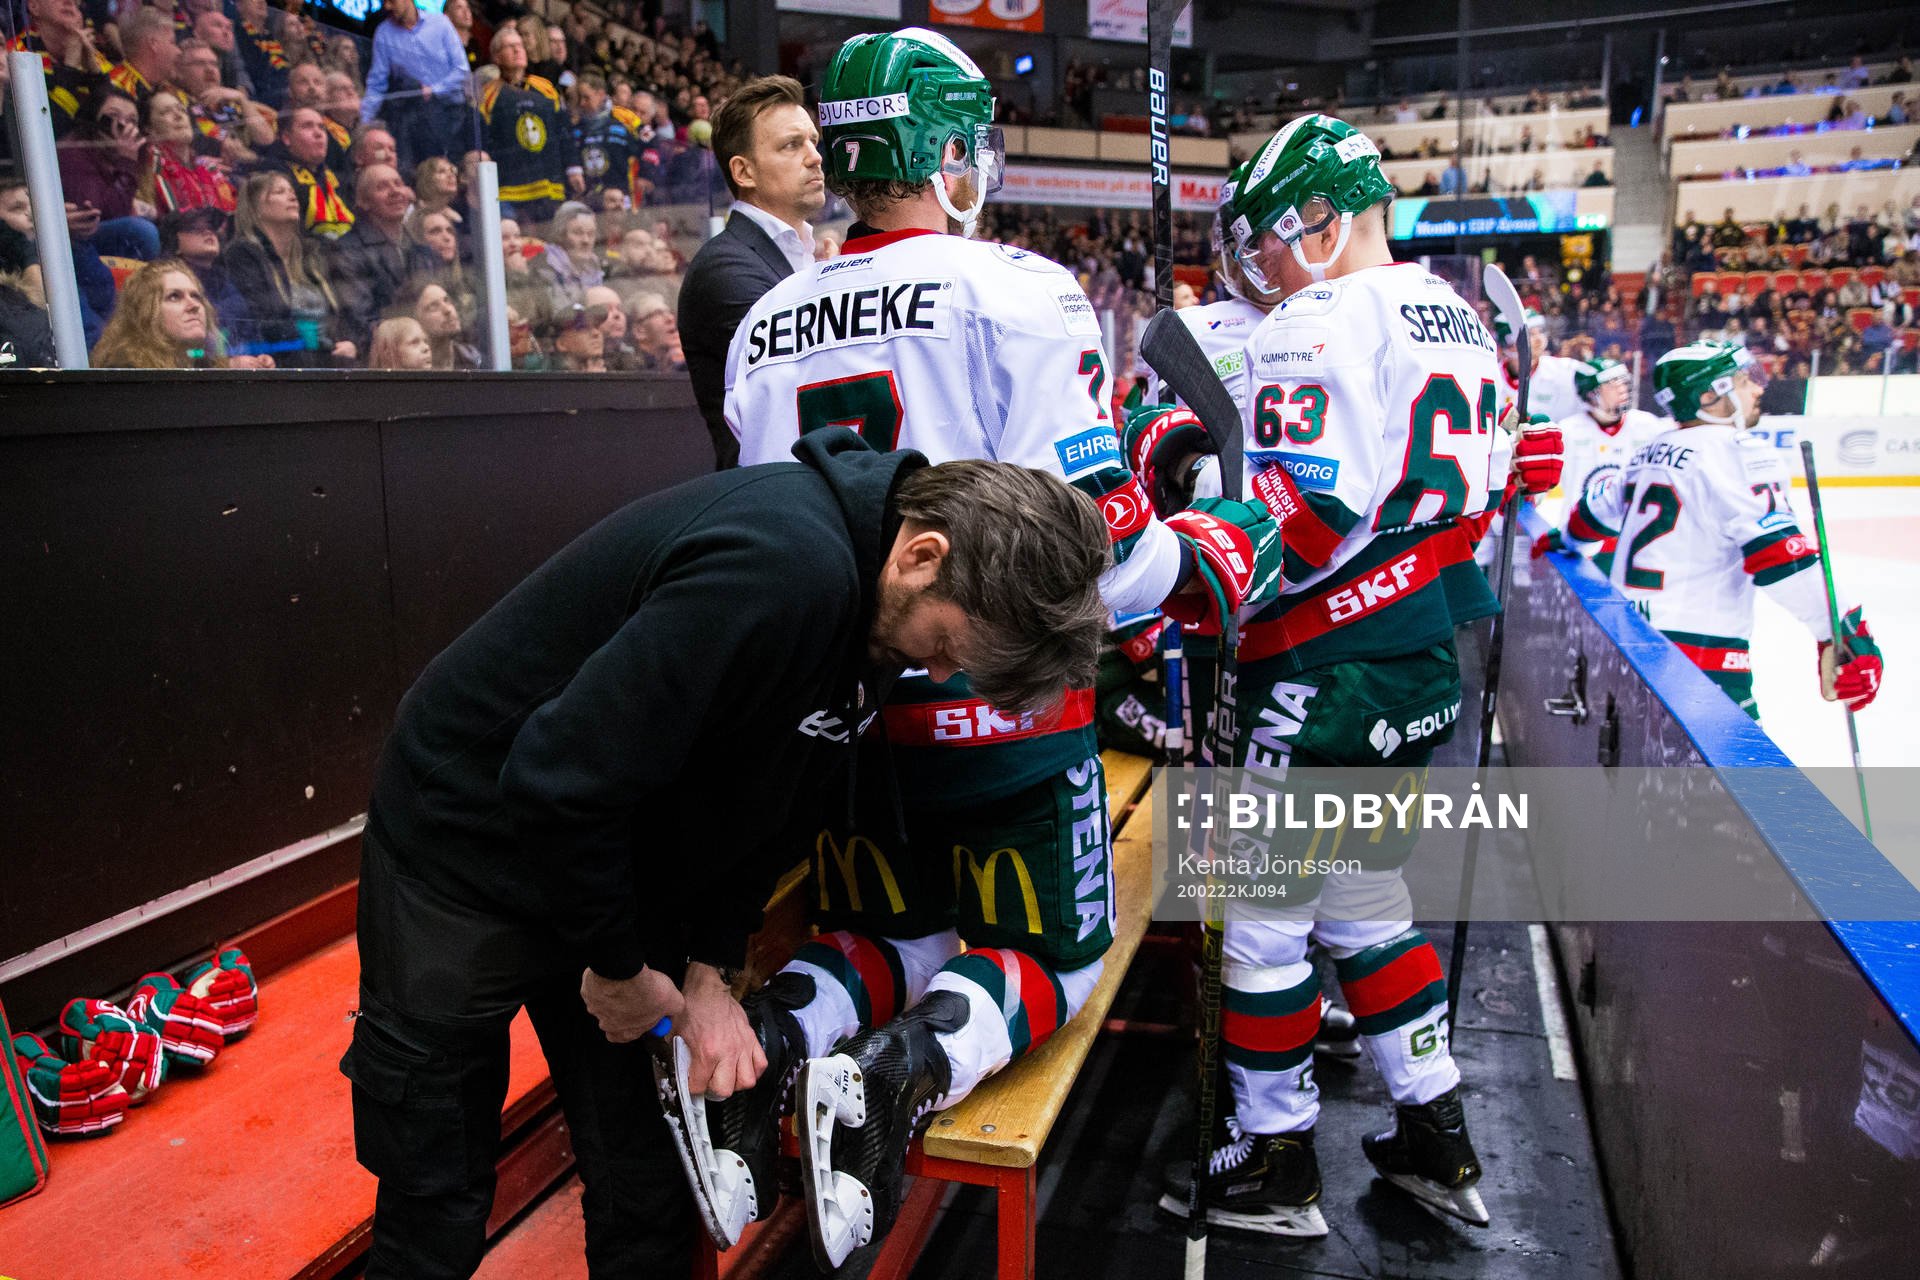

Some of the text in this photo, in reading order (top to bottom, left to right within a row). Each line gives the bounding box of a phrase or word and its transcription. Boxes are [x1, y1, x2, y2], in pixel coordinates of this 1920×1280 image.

[820, 95, 906, 125] BJURFORS
[1150, 67, 1169, 186] BAUER
[845, 141, 860, 172] 7
[820, 256, 873, 276] BAUER
[747, 282, 942, 365] SERNEKE
[1260, 351, 1314, 363] KUMHO TYRE
[1253, 383, 1330, 449] 63
[1265, 464, 1299, 516] TURKISH
[1326, 553, 1418, 623] SKF
